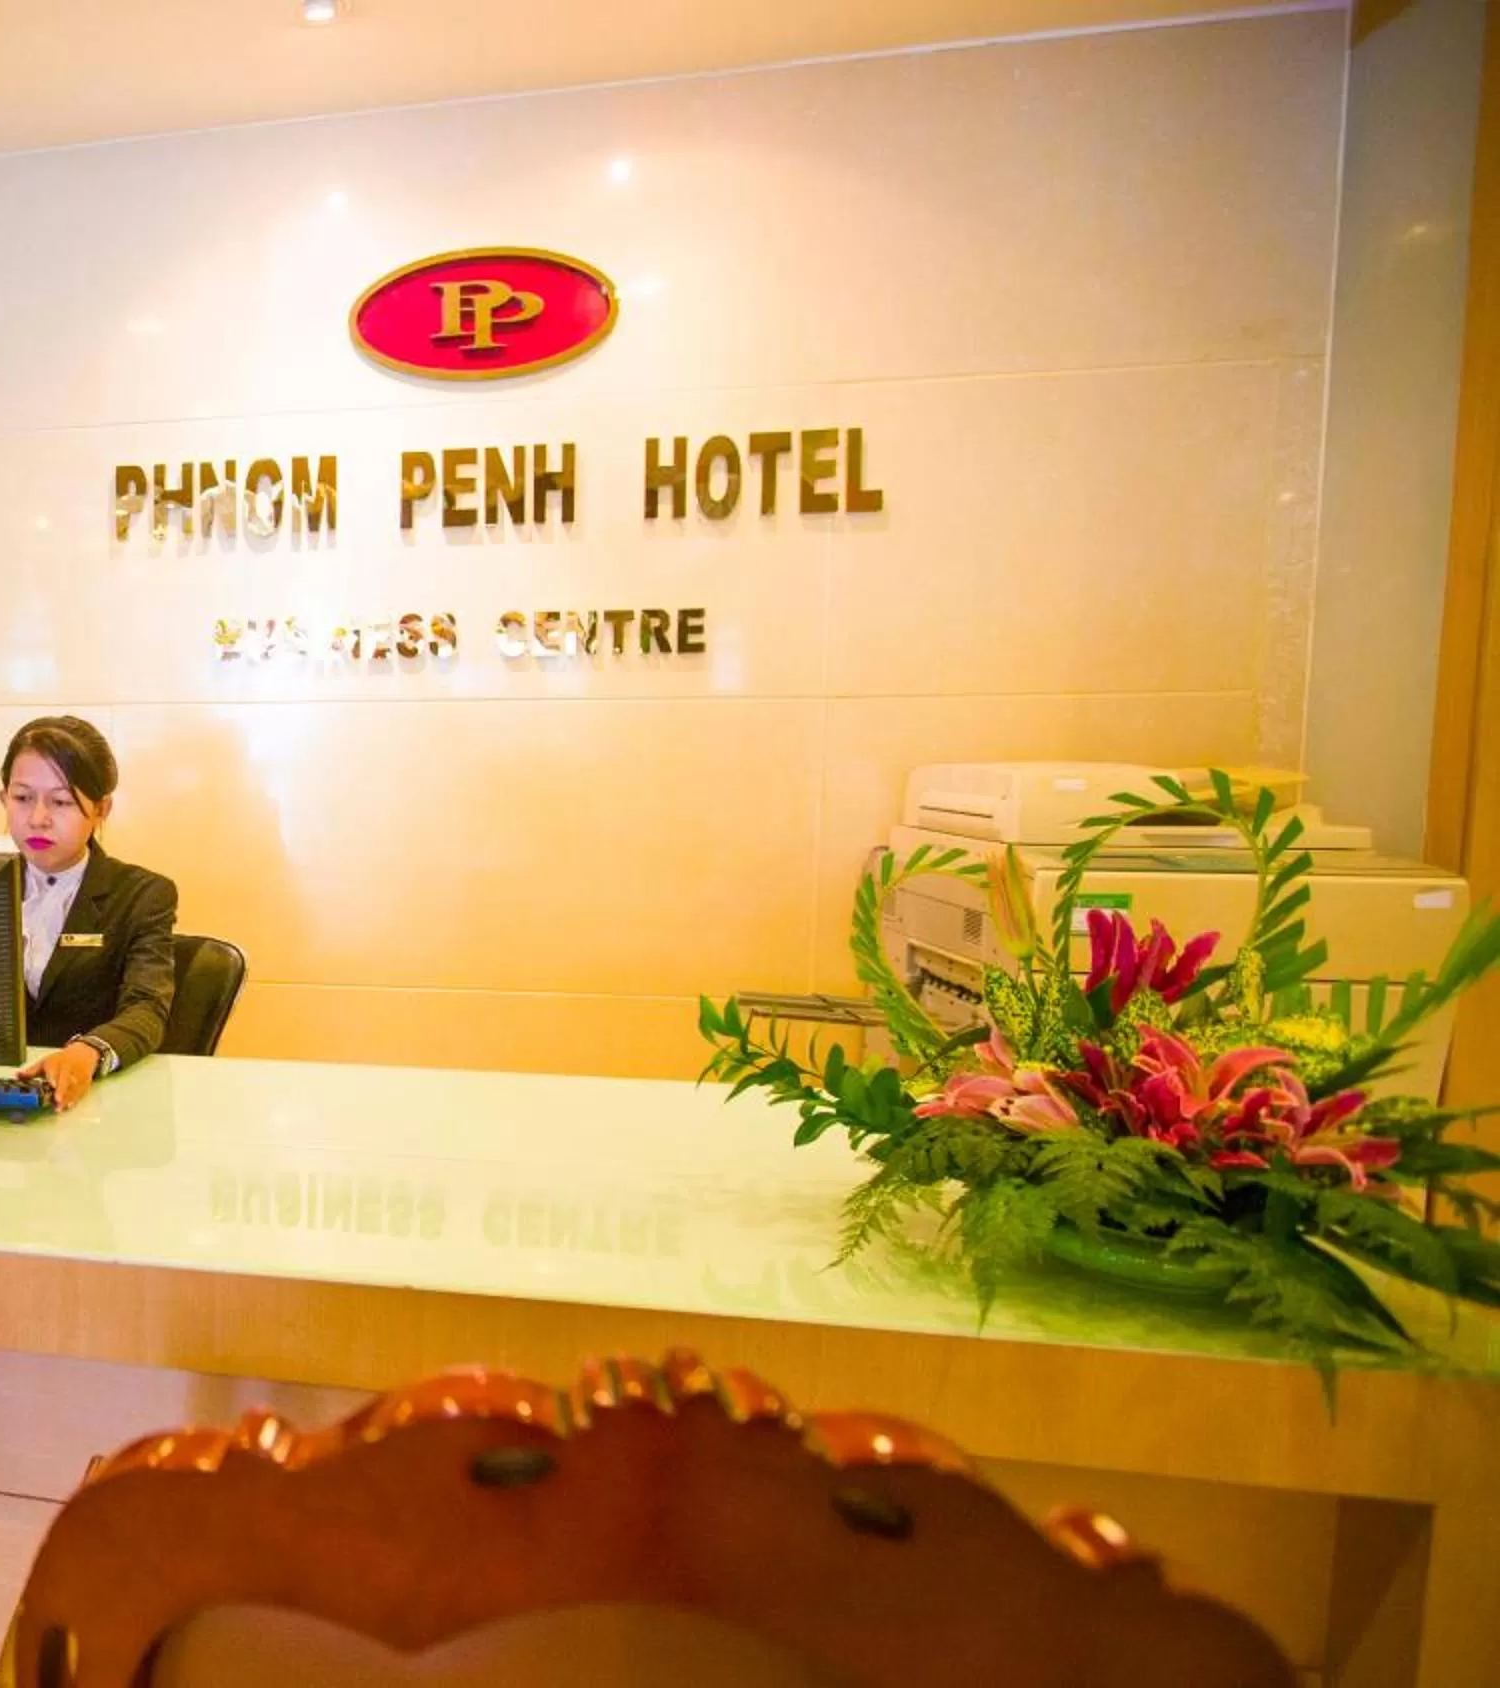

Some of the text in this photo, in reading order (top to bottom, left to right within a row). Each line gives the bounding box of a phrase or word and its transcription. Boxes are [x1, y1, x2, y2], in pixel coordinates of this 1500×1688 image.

[115, 428, 883, 542] PHNOM PENH HOTEL
[213, 608, 707, 660] BUSNESS CENTRE
